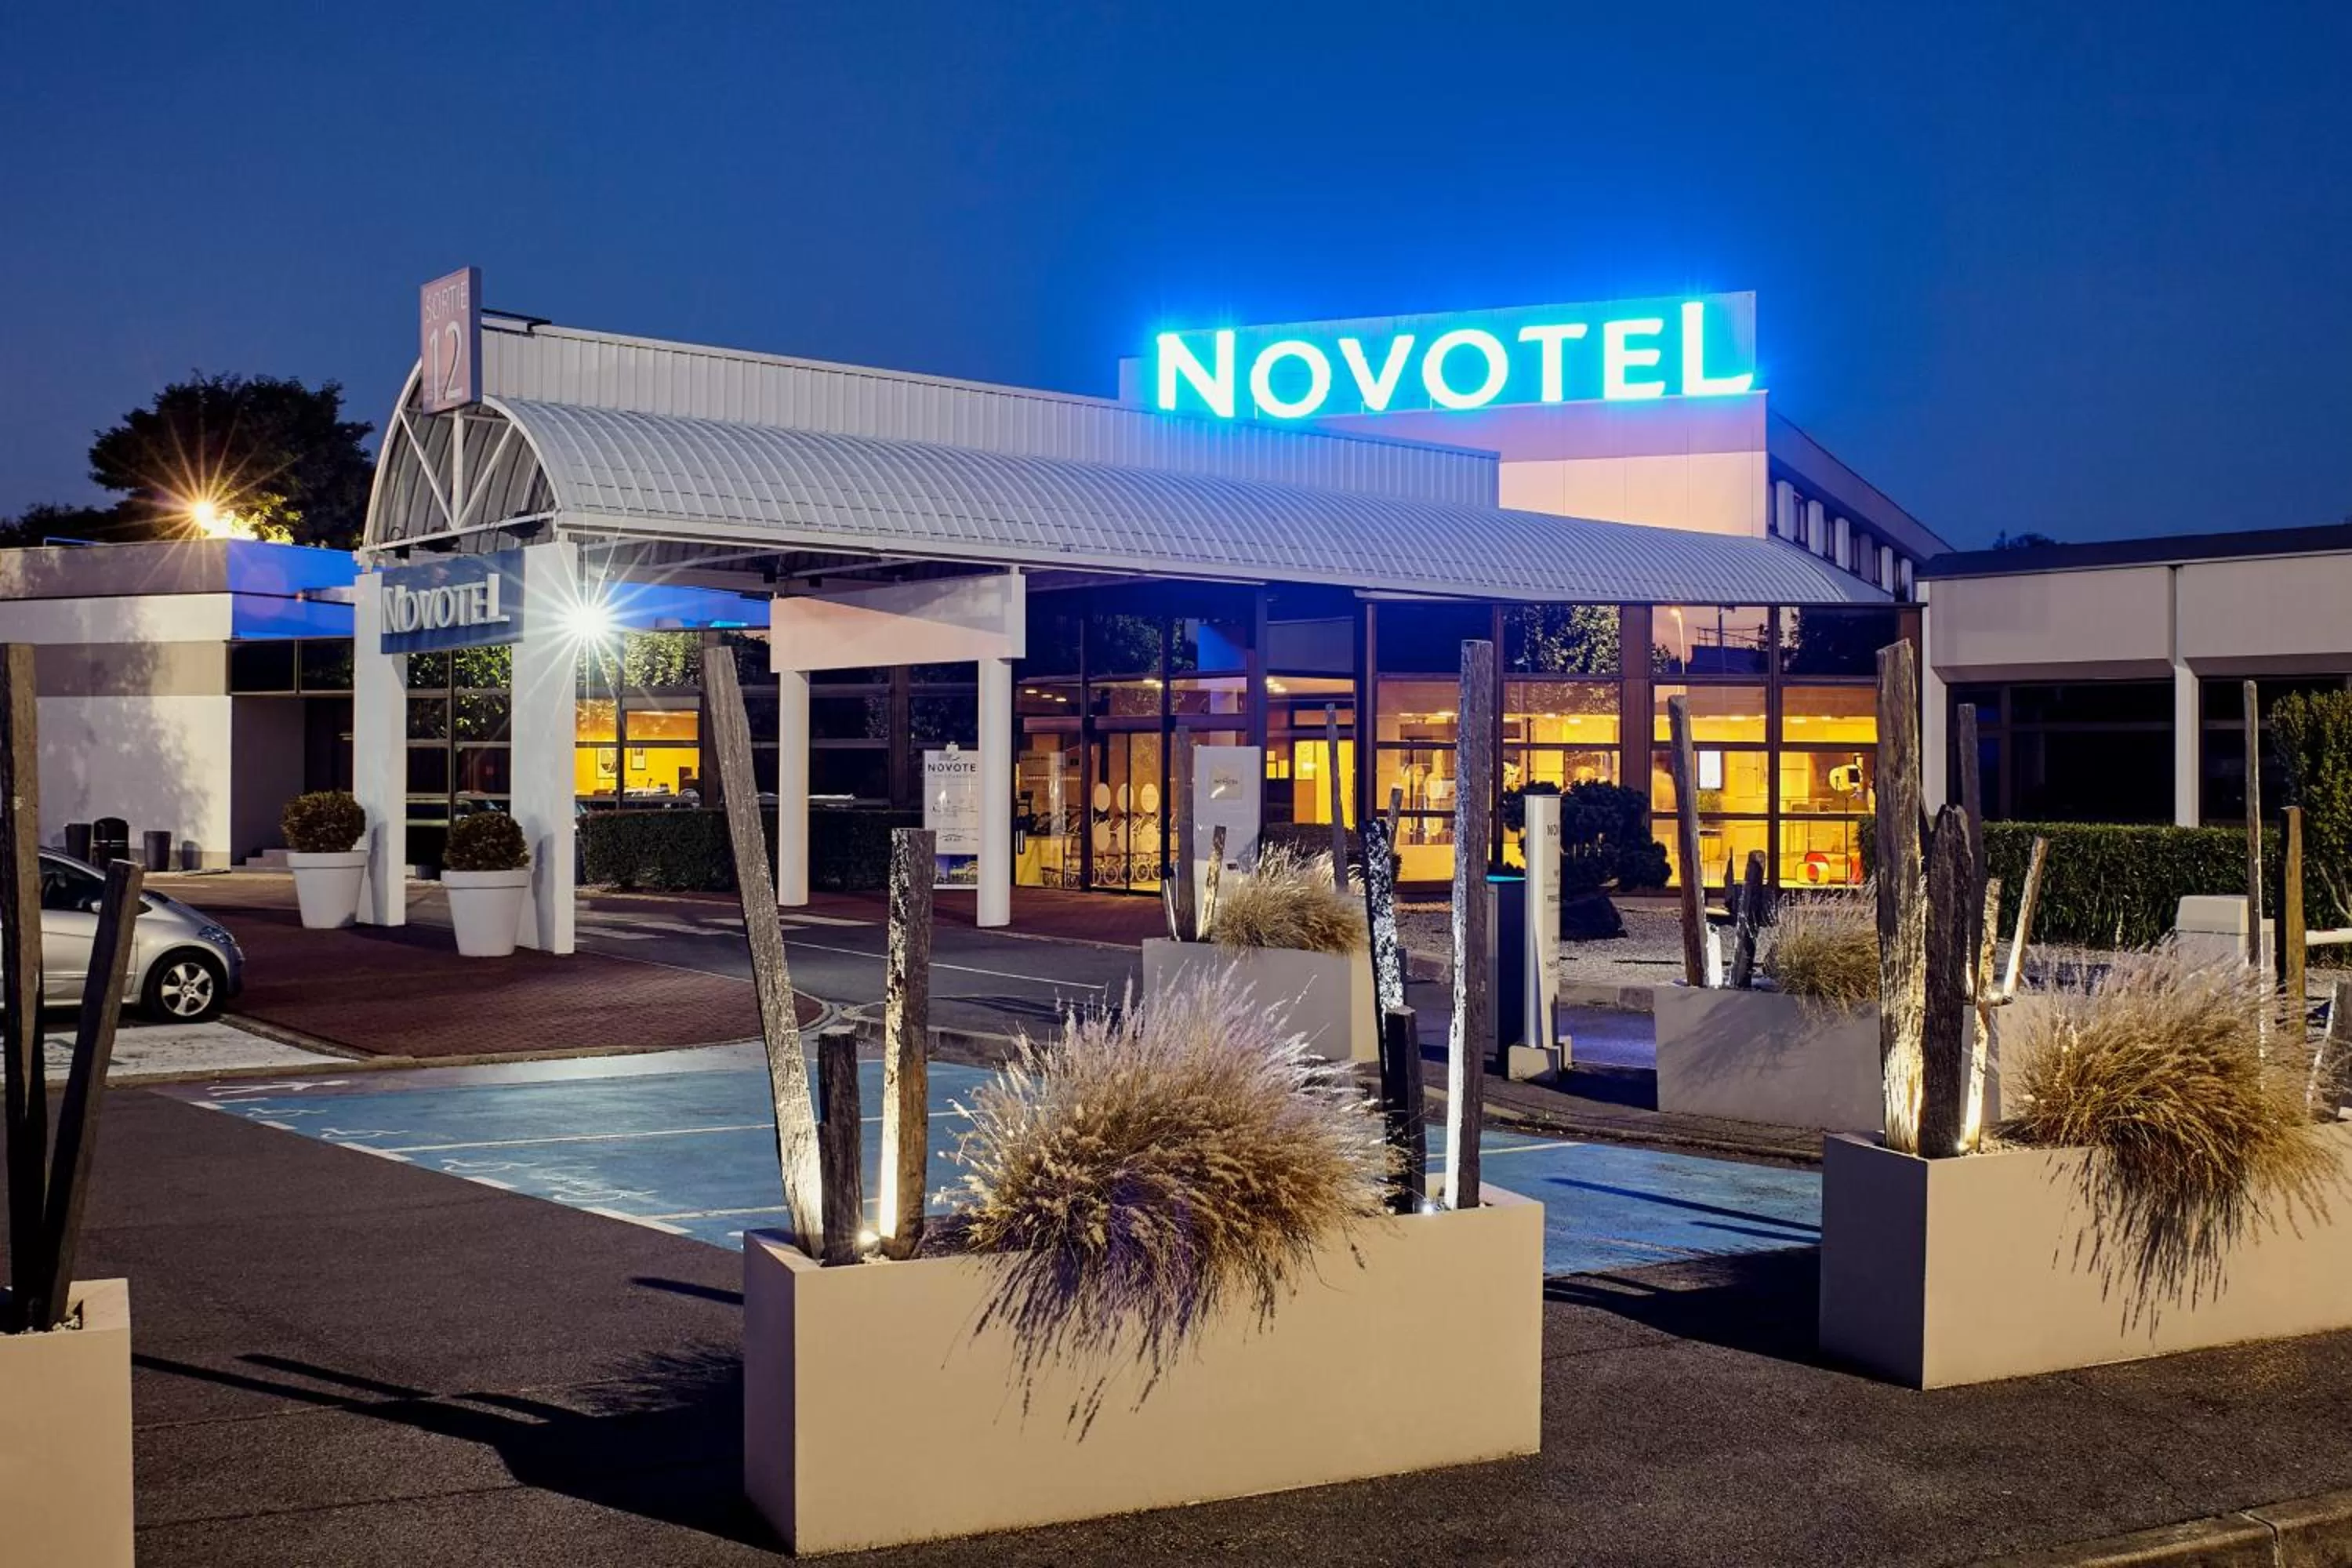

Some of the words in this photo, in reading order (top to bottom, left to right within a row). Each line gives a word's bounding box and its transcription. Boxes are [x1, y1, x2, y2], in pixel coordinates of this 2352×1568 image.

[426, 281, 468, 324] SORTIE
[430, 321, 463, 403] 12
[1156, 299, 1755, 419] NOVOTEL
[382, 573, 510, 633] NOVOTEL
